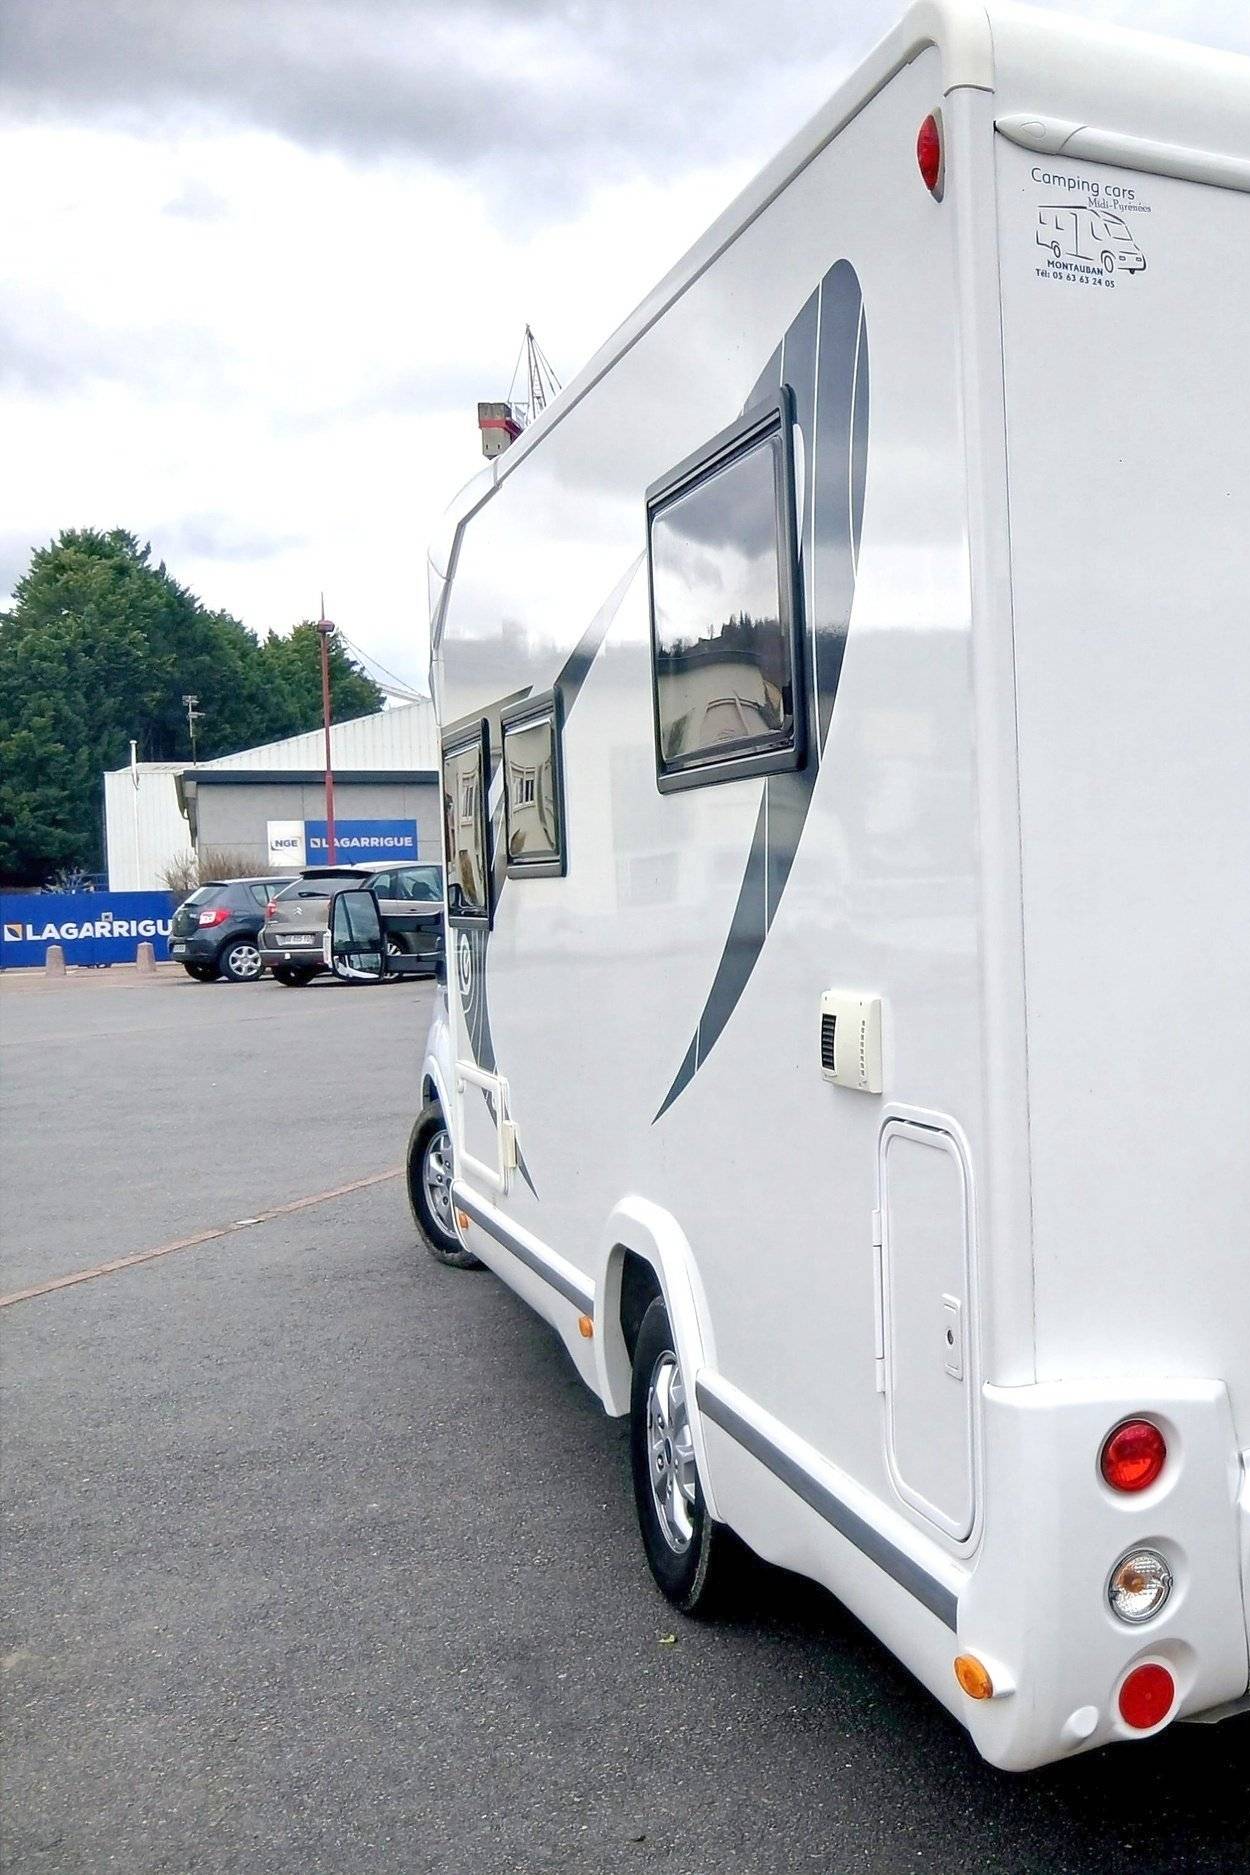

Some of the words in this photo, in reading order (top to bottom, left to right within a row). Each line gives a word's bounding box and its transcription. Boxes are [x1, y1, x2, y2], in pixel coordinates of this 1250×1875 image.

[1031, 167, 1100, 197] Camping
[1104, 184, 1135, 200] cars
[1047, 260, 1103, 276] MONTAUBAN
[1052, 270, 1064, 281] 05
[1066, 273, 1077, 283] 63
[1079, 275, 1090, 285] 63
[1092, 278, 1102, 287] 24
[1104, 279, 1115, 289] 05
[275, 839, 299, 848] NGE
[322, 836, 413, 848] LAGARRIGUE
[26, 920, 173, 940] LAGARRIGU
